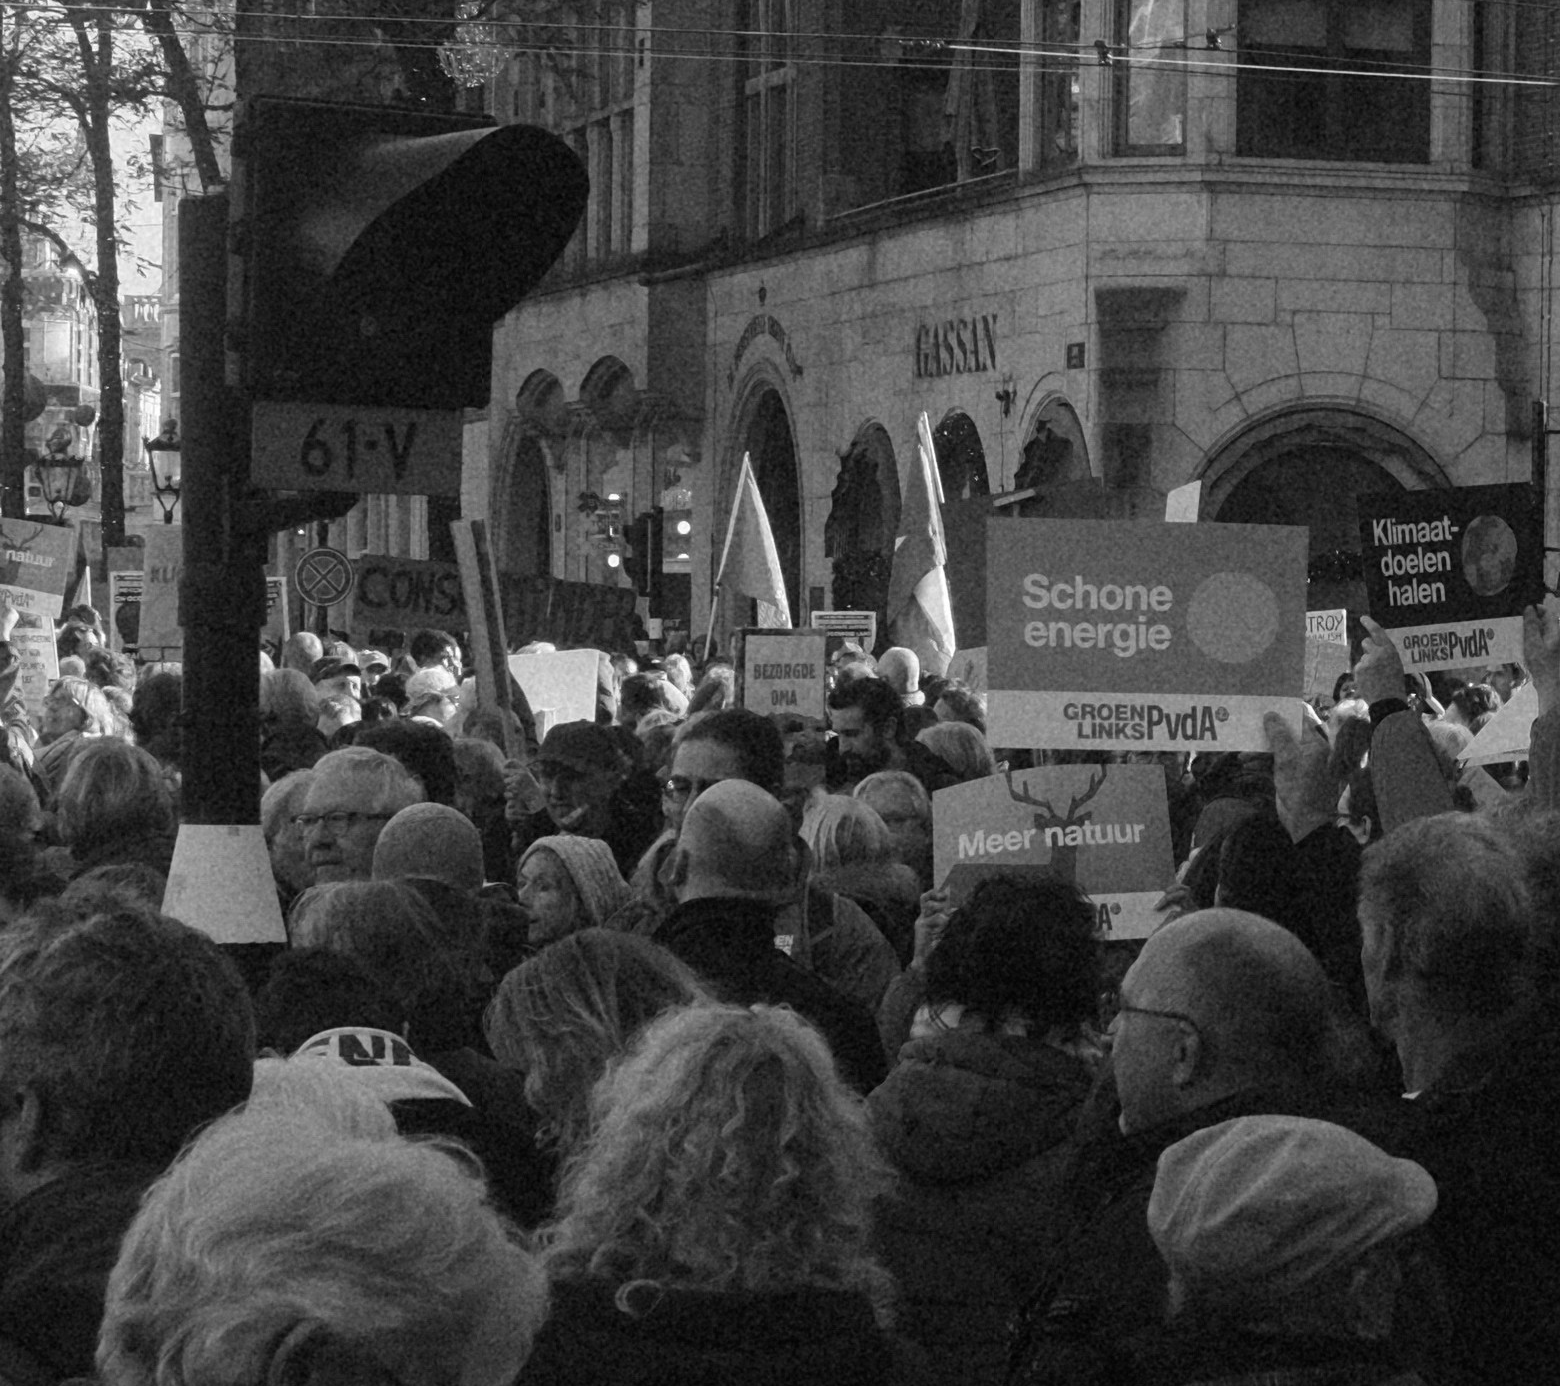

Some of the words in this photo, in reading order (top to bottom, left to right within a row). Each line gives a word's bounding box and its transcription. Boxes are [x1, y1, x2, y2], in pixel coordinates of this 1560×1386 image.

[914, 313, 998, 379] GASSAN
[1372, 514, 1460, 546] Klimaat-
[5, 549, 56, 568] natuur
[1380, 546, 1452, 576] doelen
[1022, 572, 1173, 611] Schone
[1387, 579, 1446, 606] halen
[1023, 616, 1172, 658] energie
[1307, 614, 1344, 633] TROY
[1402, 633, 1448, 649] GROEN
[1448, 628, 1489, 660] PvdA
[1411, 647, 1449, 663] LINKS
[753, 663, 816, 680] BEZORGDE
[771, 689, 798, 706] OMA
[1062, 702, 1146, 722] GROEN
[1146, 704, 1218, 742] PvdA
[1077, 721, 1146, 741] LINKS
[958, 827, 1037, 859] Meer
[1044, 819, 1145, 847] natuur
